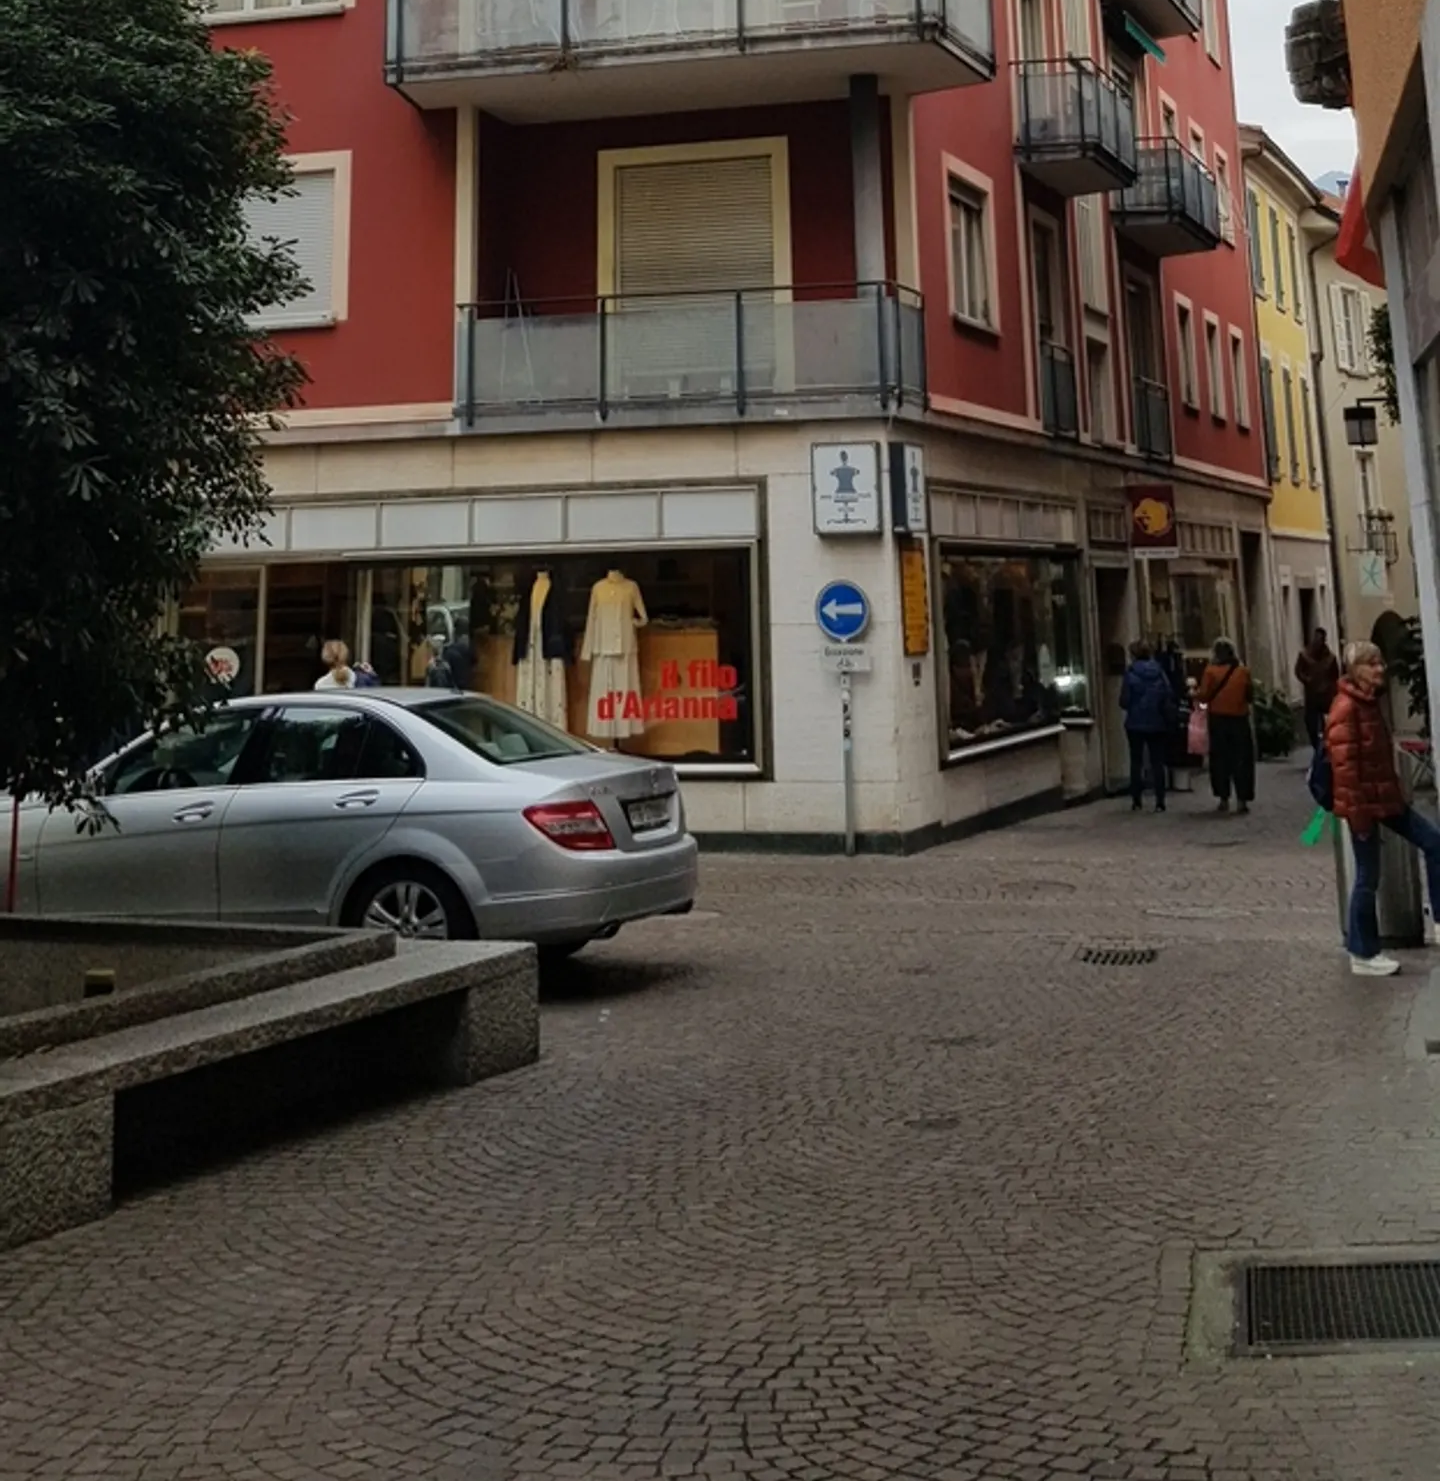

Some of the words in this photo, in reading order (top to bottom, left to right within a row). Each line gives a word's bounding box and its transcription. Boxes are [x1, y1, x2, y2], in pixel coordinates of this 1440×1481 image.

[661, 659, 678, 689] il
[688, 659, 737, 689] filo
[597, 690, 737, 721] d'Arianna
